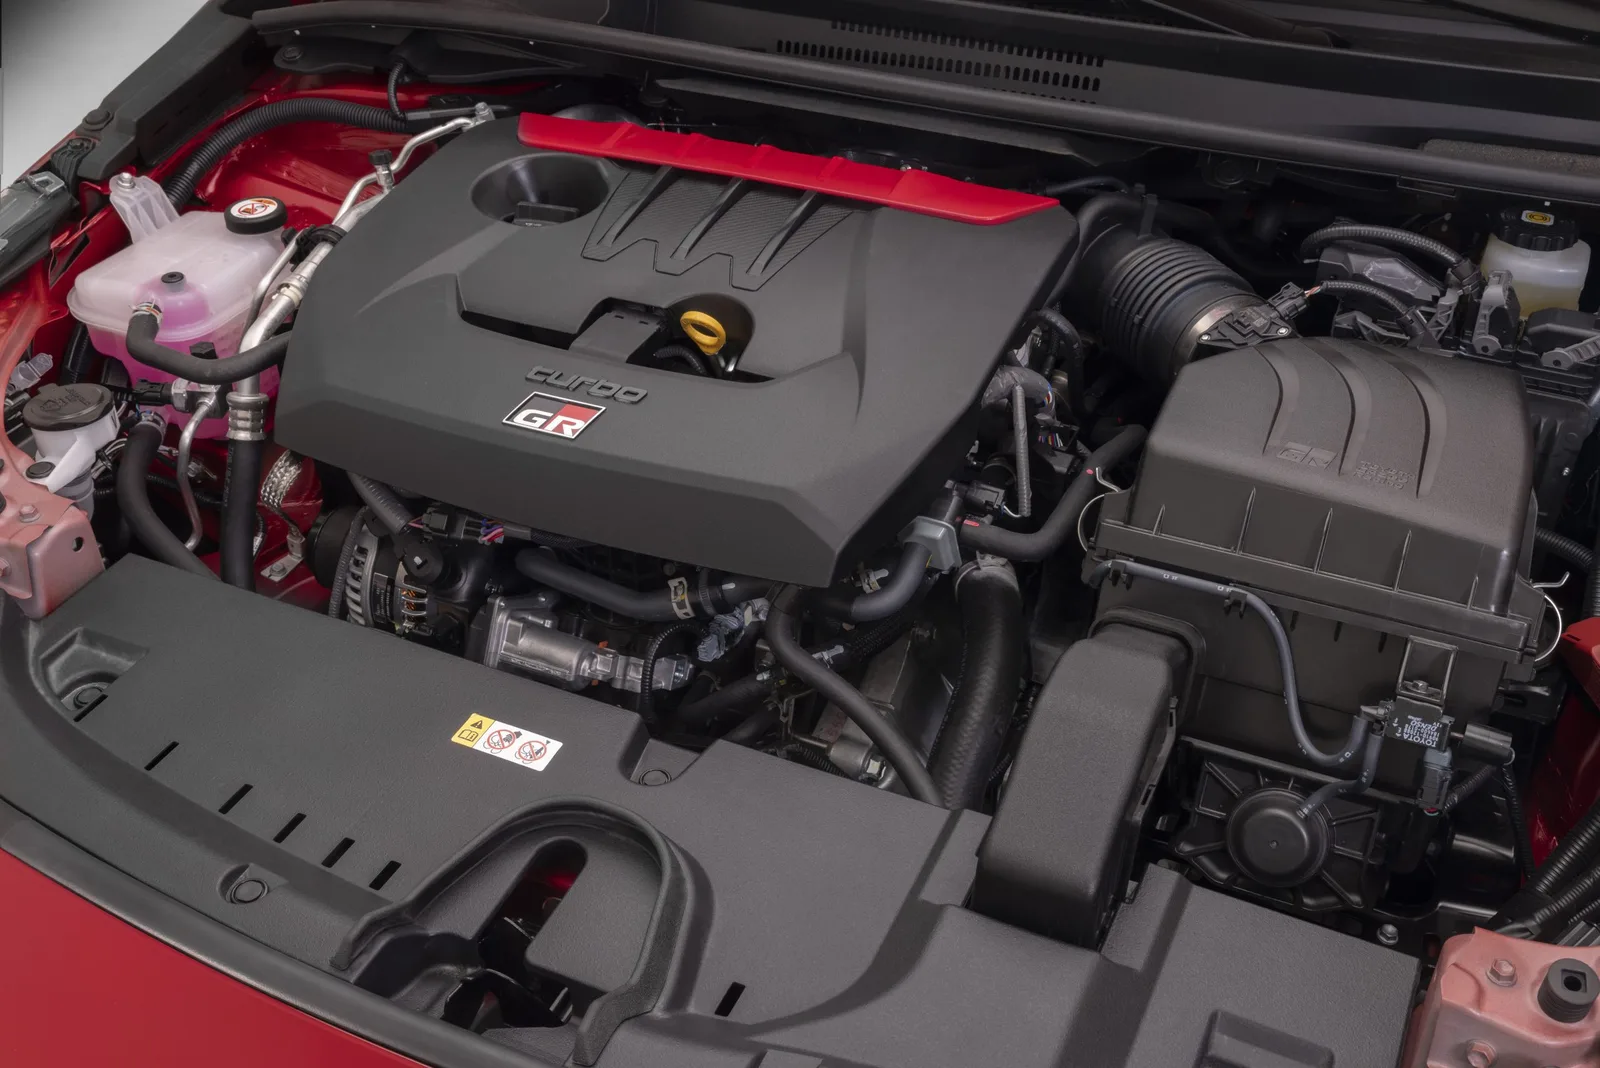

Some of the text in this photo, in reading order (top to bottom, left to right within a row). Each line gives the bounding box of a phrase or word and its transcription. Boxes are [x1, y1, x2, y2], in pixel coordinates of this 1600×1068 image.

[525, 365, 648, 404] turbo
[512, 408, 586, 436] GR
[1277, 445, 1334, 470] GR
[1410, 720, 1438, 731] DENSO
[1402, 732, 1437, 747] TOYOTA
